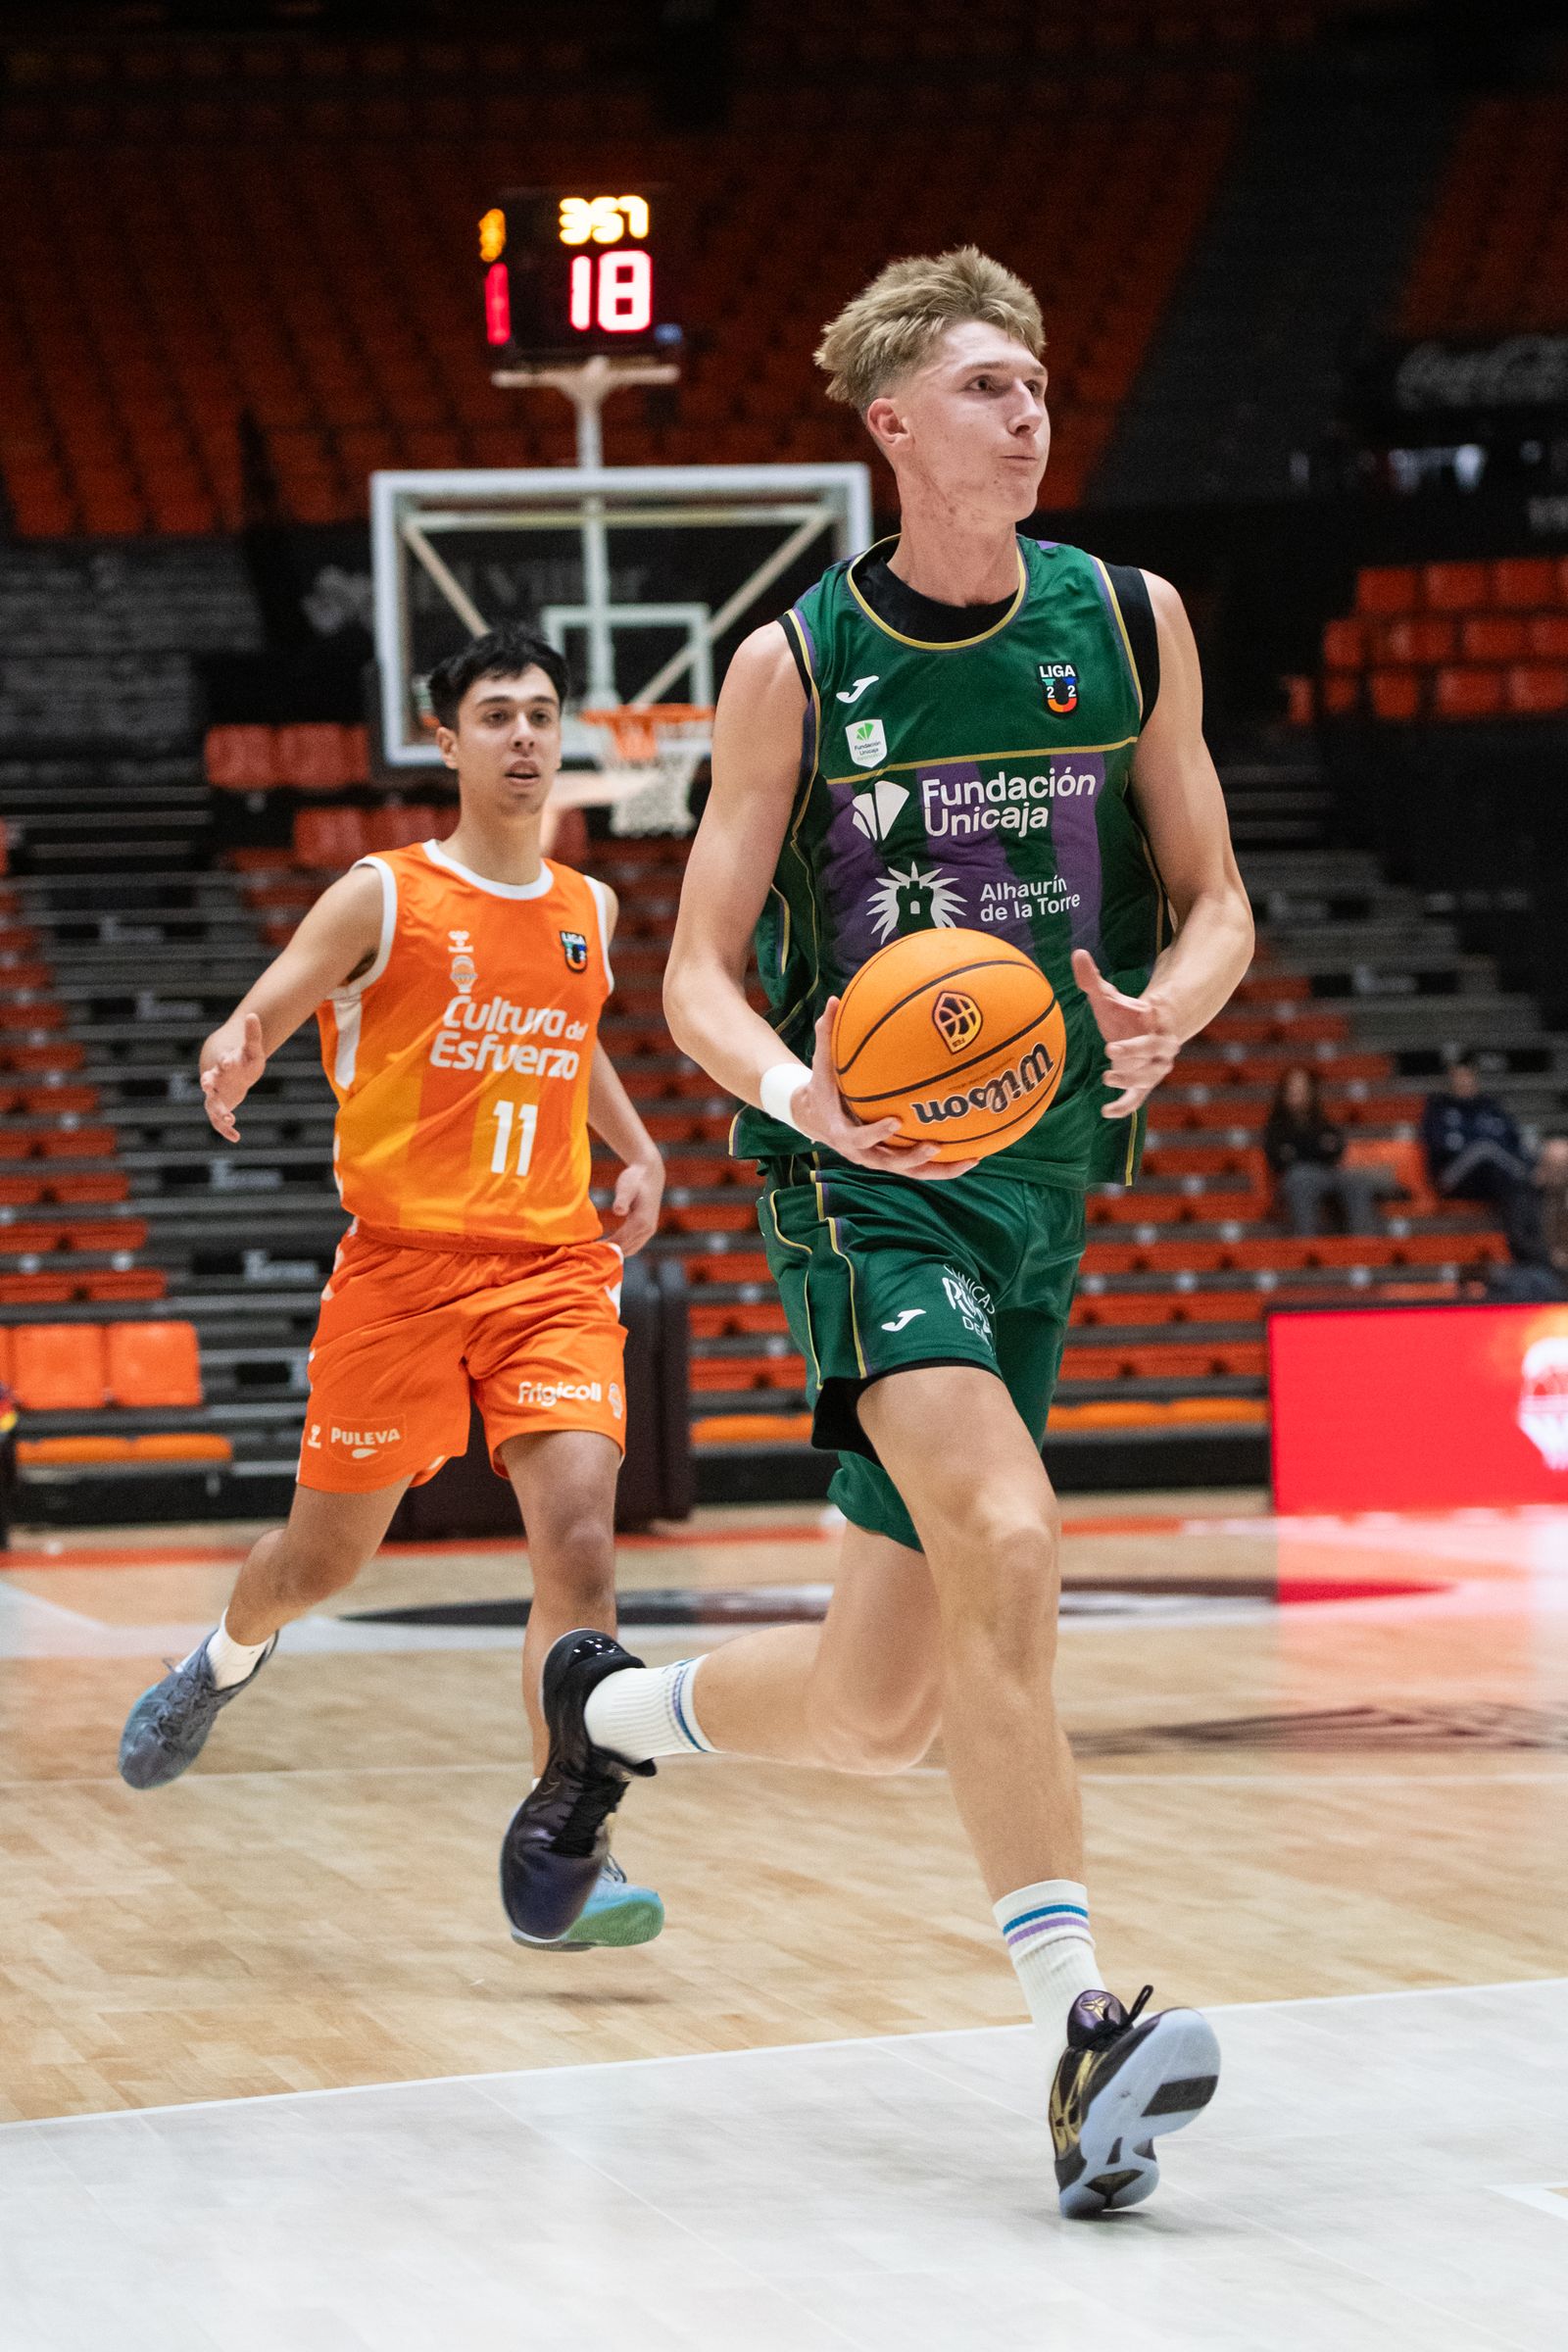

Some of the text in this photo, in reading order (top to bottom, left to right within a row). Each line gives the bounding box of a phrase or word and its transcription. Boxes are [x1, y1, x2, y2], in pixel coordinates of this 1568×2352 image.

[570, 250, 652, 331] 18
[1039, 664, 1076, 678] LIGA
[921, 766, 1097, 808] Fundación
[924, 802, 1049, 838] Unicaja
[980, 874, 1067, 902] Alhaurín
[981, 893, 1080, 922] de la Torre
[443, 995, 567, 1038] Cultura
[429, 1031, 579, 1081] Esfuerzo
[909, 1042, 1054, 1124] Wilson
[491, 1100, 539, 1176] 11
[330, 1427, 401, 1446] PULEVA
